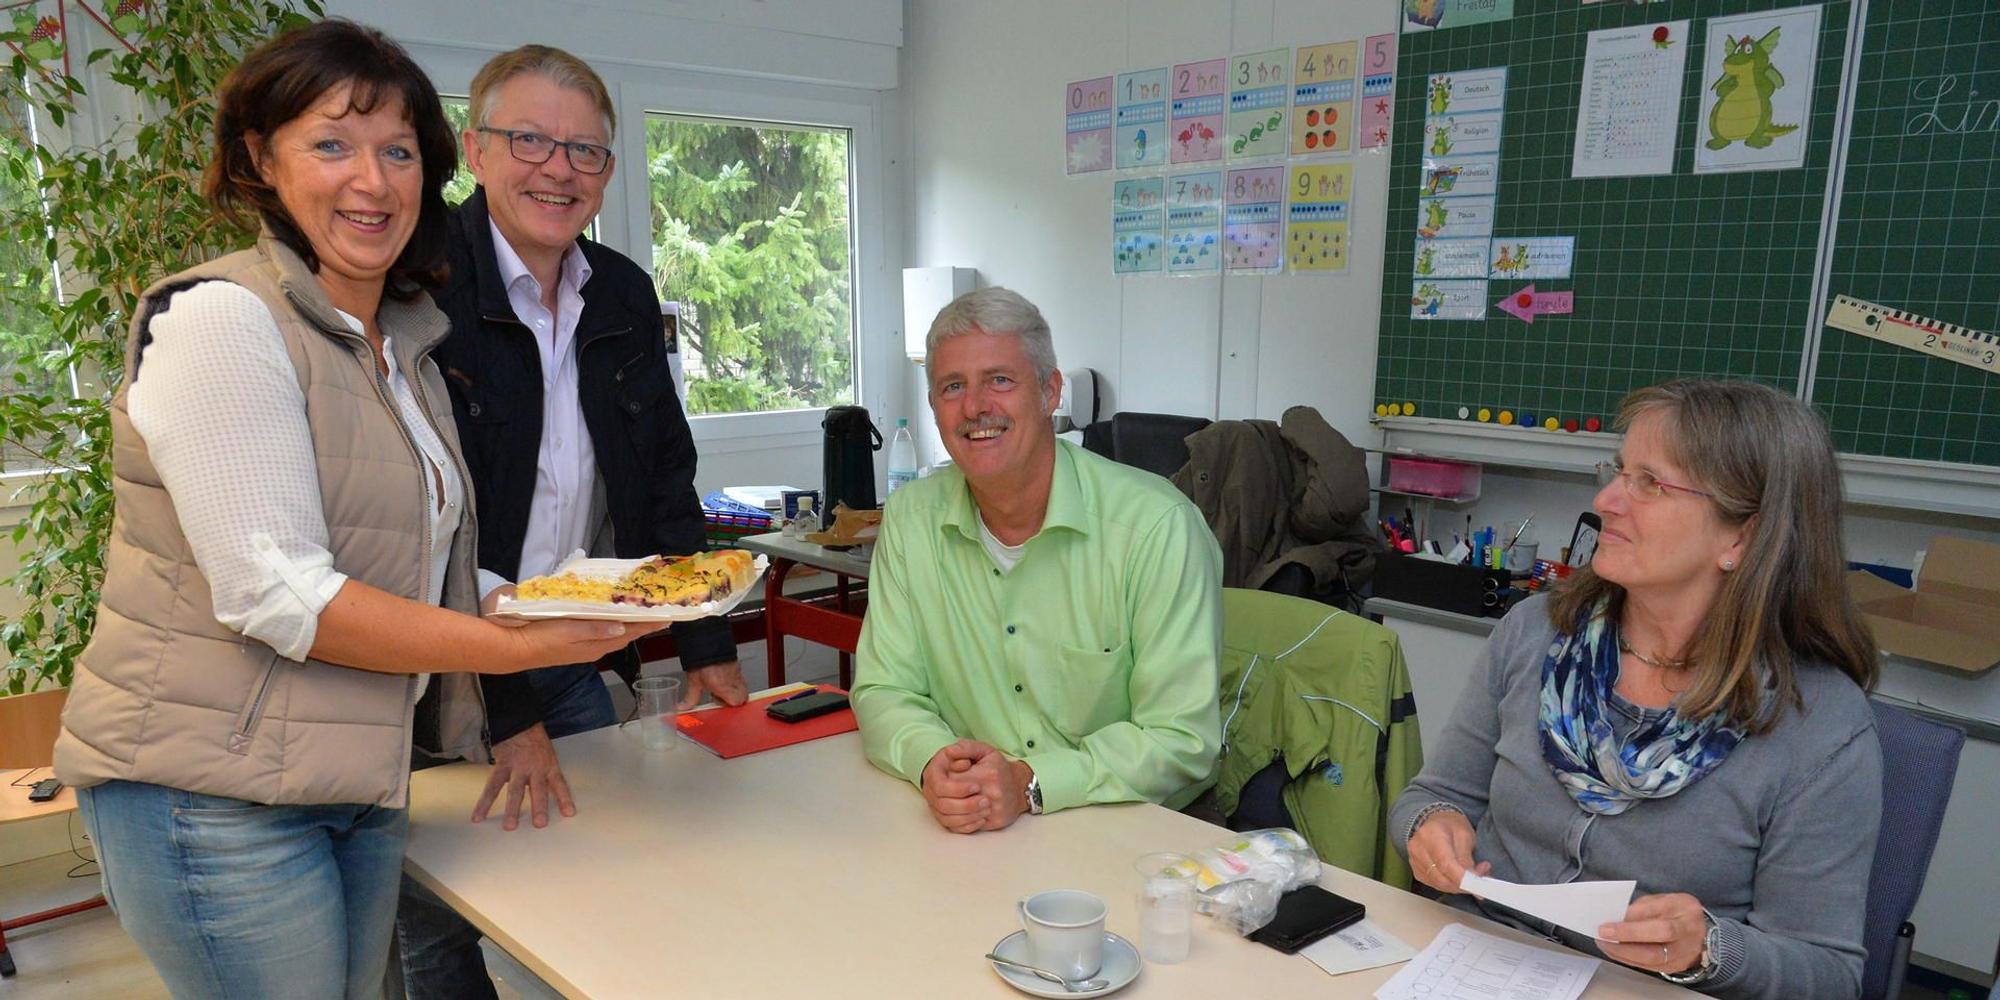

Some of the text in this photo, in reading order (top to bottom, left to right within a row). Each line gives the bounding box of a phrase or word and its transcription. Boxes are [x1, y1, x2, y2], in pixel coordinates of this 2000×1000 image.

[1303, 52, 1316, 77] 4
[1373, 41, 1387, 68] 5
[1179, 70, 1190, 93] 2
[1239, 61, 1250, 85] 3
[1071, 87, 1083, 109] 0
[1126, 78, 1133, 100] 1
[1464, 84, 1490, 94] Deutsch
[1464, 127, 1489, 136] Religion
[1175, 180, 1187, 202] 7
[1234, 176, 1246, 198] 8
[1299, 172, 1310, 196] 9
[1120, 186, 1130, 207] 6
[1458, 211, 1476, 219] Pause
[1875, 320, 1881, 332] 1
[1923, 334, 1936, 348] 2
[1982, 350, 1995, 364] 3
